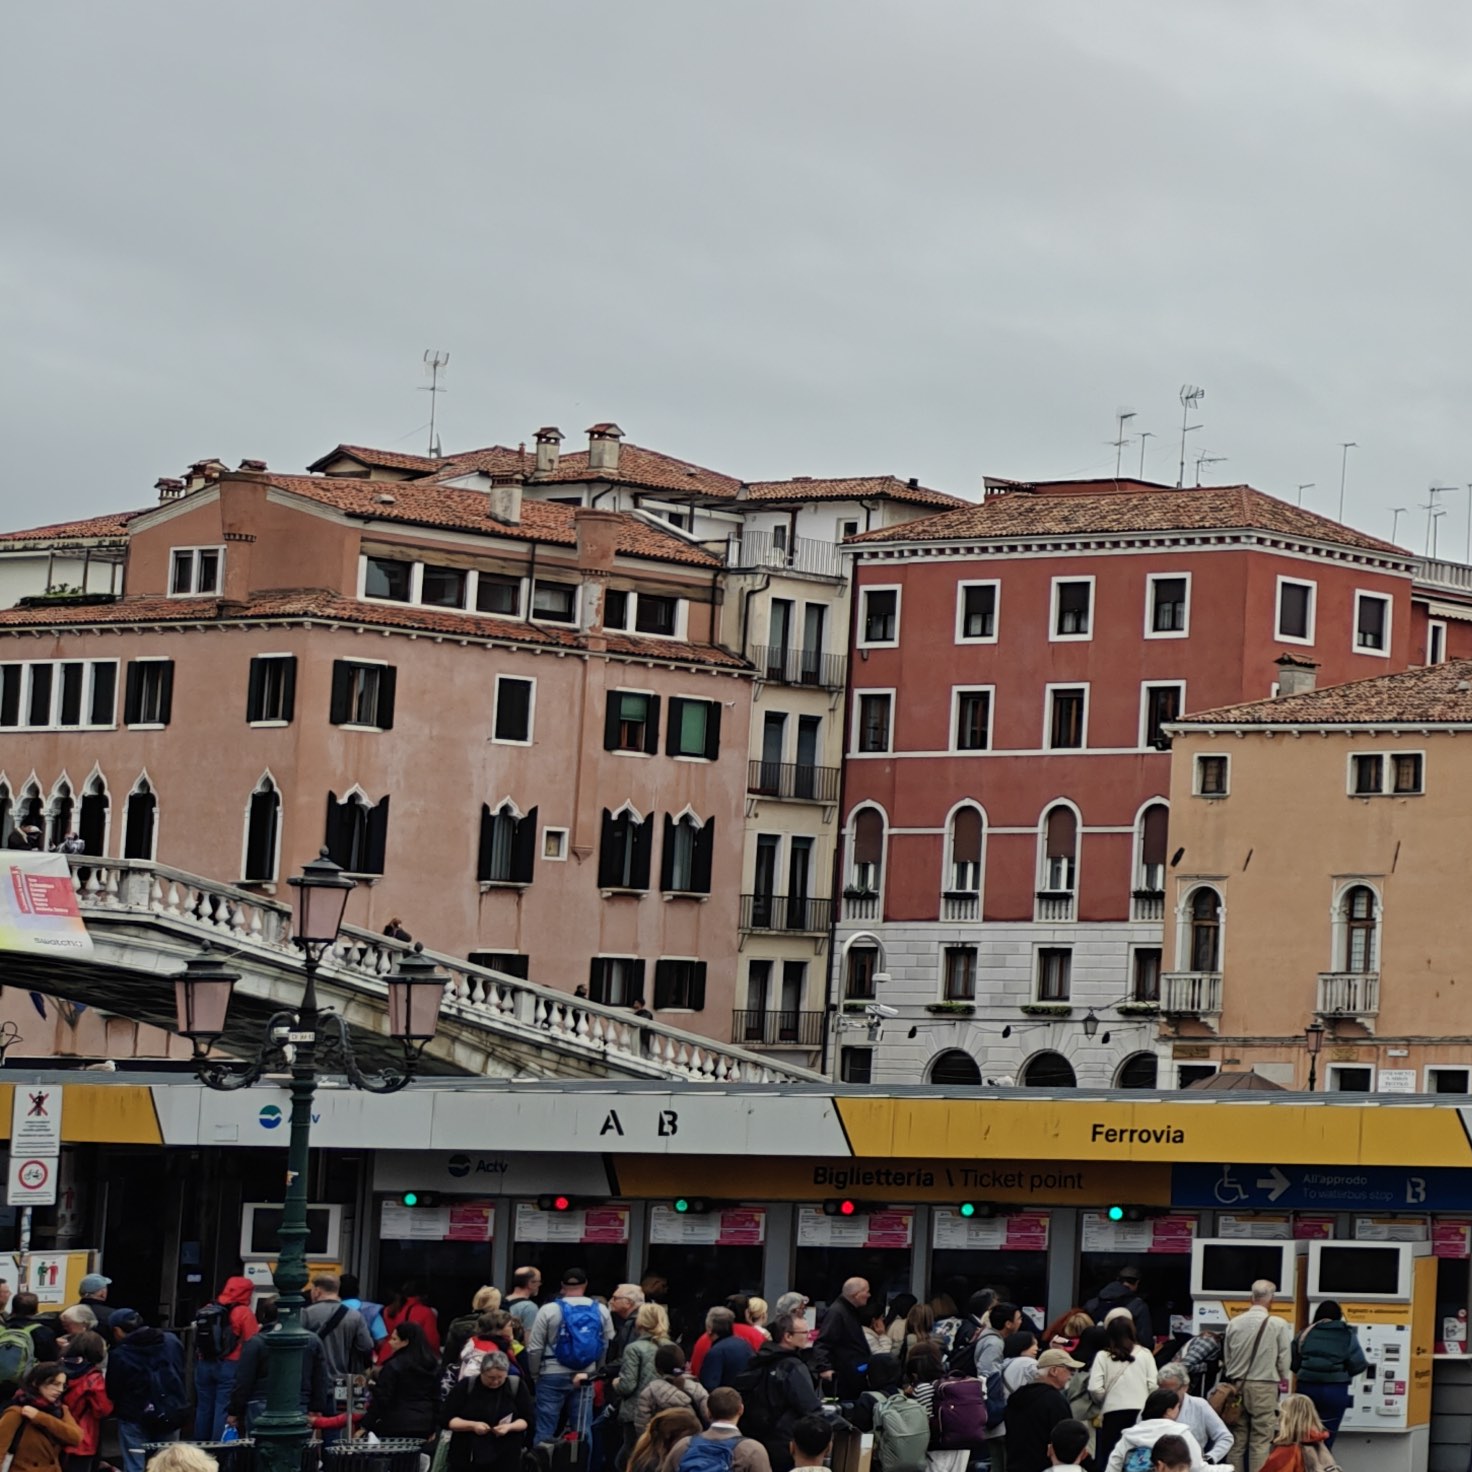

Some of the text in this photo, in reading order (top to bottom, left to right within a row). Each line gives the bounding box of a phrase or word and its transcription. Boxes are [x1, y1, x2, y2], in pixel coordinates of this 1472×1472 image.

[600, 1110, 678, 1136] A B
[1092, 1124, 1184, 1143] Ferrovia
[475, 1159, 508, 1173] Actv
[814, 1166, 934, 1190] Biglietteria
[960, 1169, 1023, 1188] Ticket
[1031, 1172, 1084, 1194] point
[1406, 1178, 1426, 1203] B
